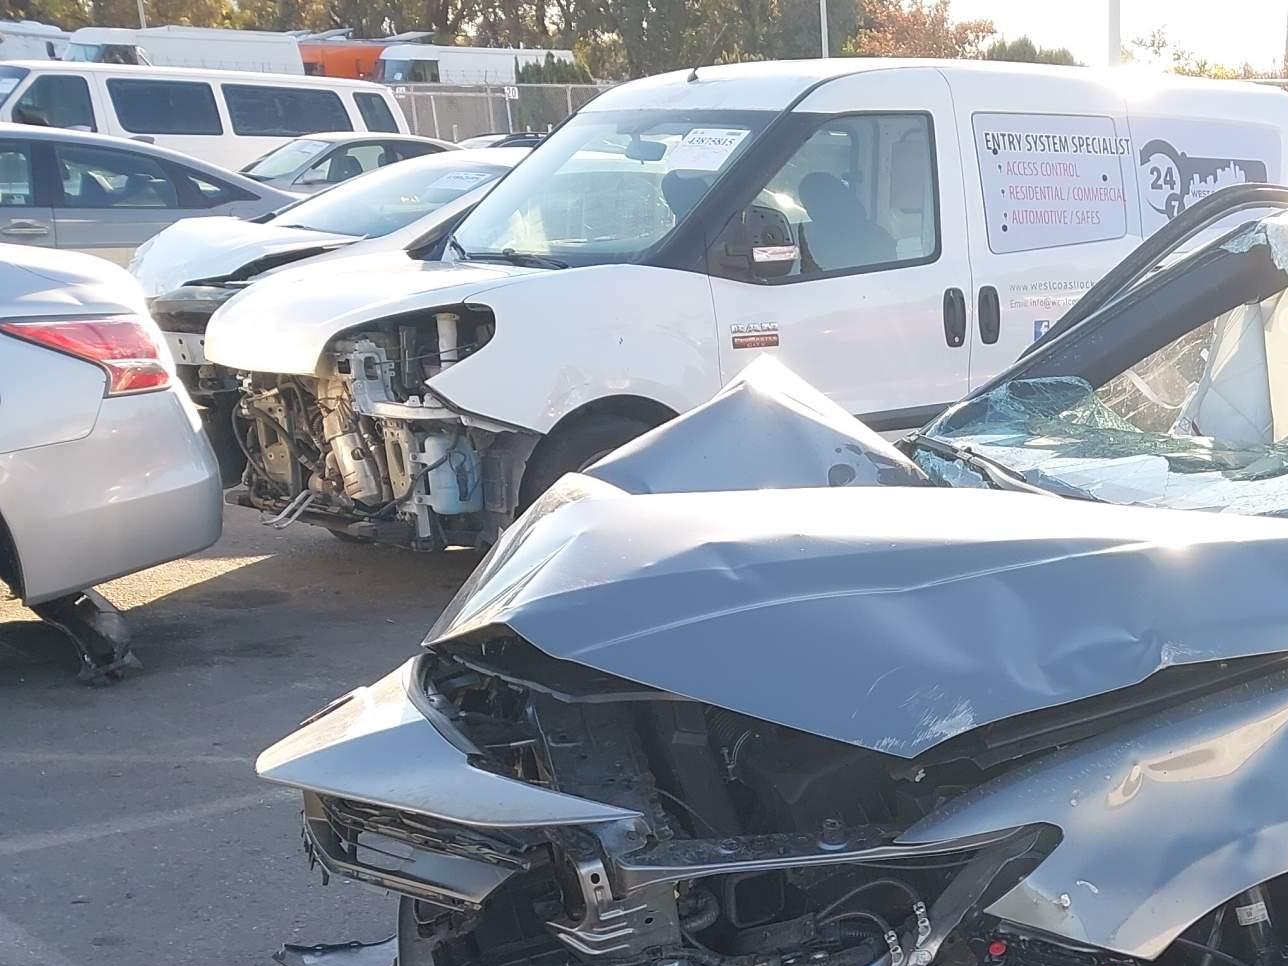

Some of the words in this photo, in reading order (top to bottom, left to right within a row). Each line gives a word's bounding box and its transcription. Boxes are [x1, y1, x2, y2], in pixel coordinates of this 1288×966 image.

[984, 132, 1021, 151] ENTRY
[1025, 134, 1069, 153] SYSTEM
[1071, 136, 1130, 155] SPECIALIST
[1006, 161, 1039, 176] ACCESS
[1040, 162, 1080, 178] CONTROL
[1149, 166, 1176, 191] 24
[1009, 185, 1065, 201] RESIDENTIAL
[1072, 187, 1127, 202] COMMERCIAL
[1012, 209, 1068, 225] AUTOMOTIVE
[1075, 210, 1100, 225] SAFES
[1171, 201, 1180, 217] 7
[731, 323, 778, 333] RAM
